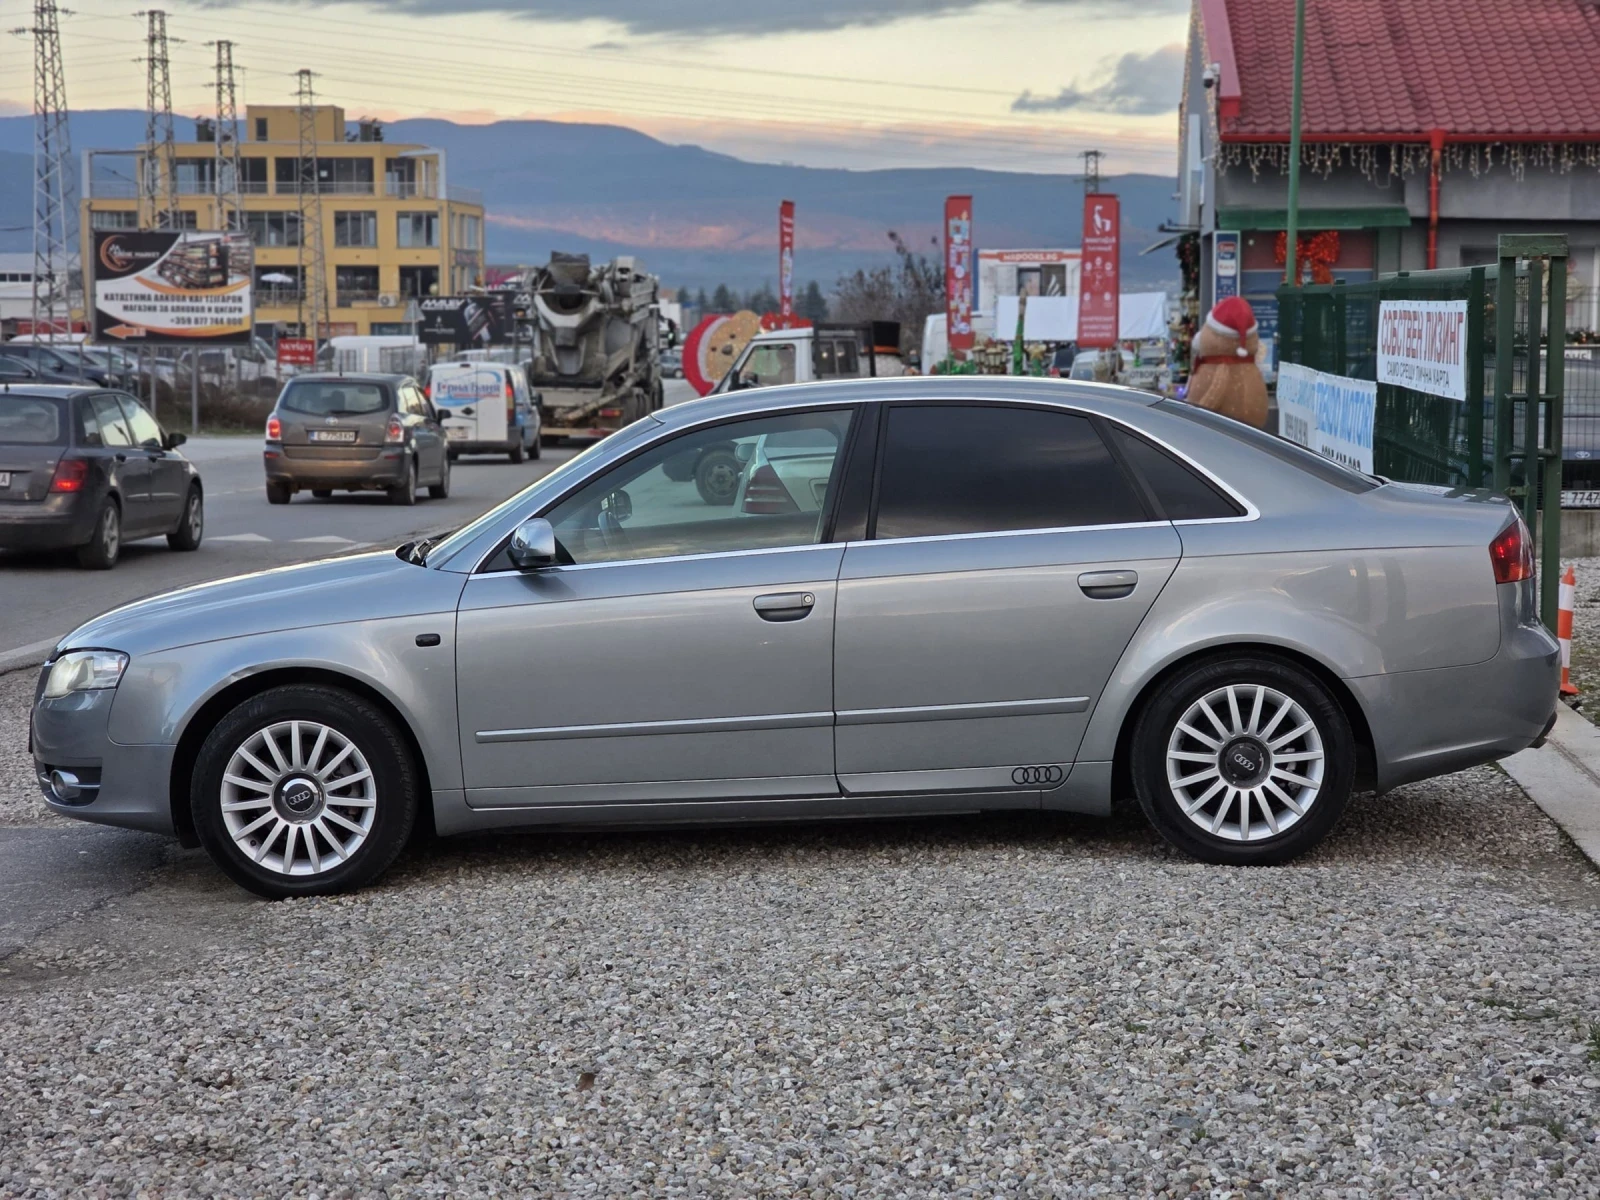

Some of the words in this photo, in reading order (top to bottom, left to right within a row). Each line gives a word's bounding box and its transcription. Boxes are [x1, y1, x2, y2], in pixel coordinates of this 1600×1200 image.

[1381, 309, 1424, 360] СОБСТВЕН
[1424, 310, 1464, 366] ЛИЗИНГ
[1387, 360, 1399, 377] САМО
[1400, 362, 1415, 381] СРЕЩУ
[1416, 365, 1432, 384] ЛИЧНА
[1433, 368, 1449, 388] КАРТА
